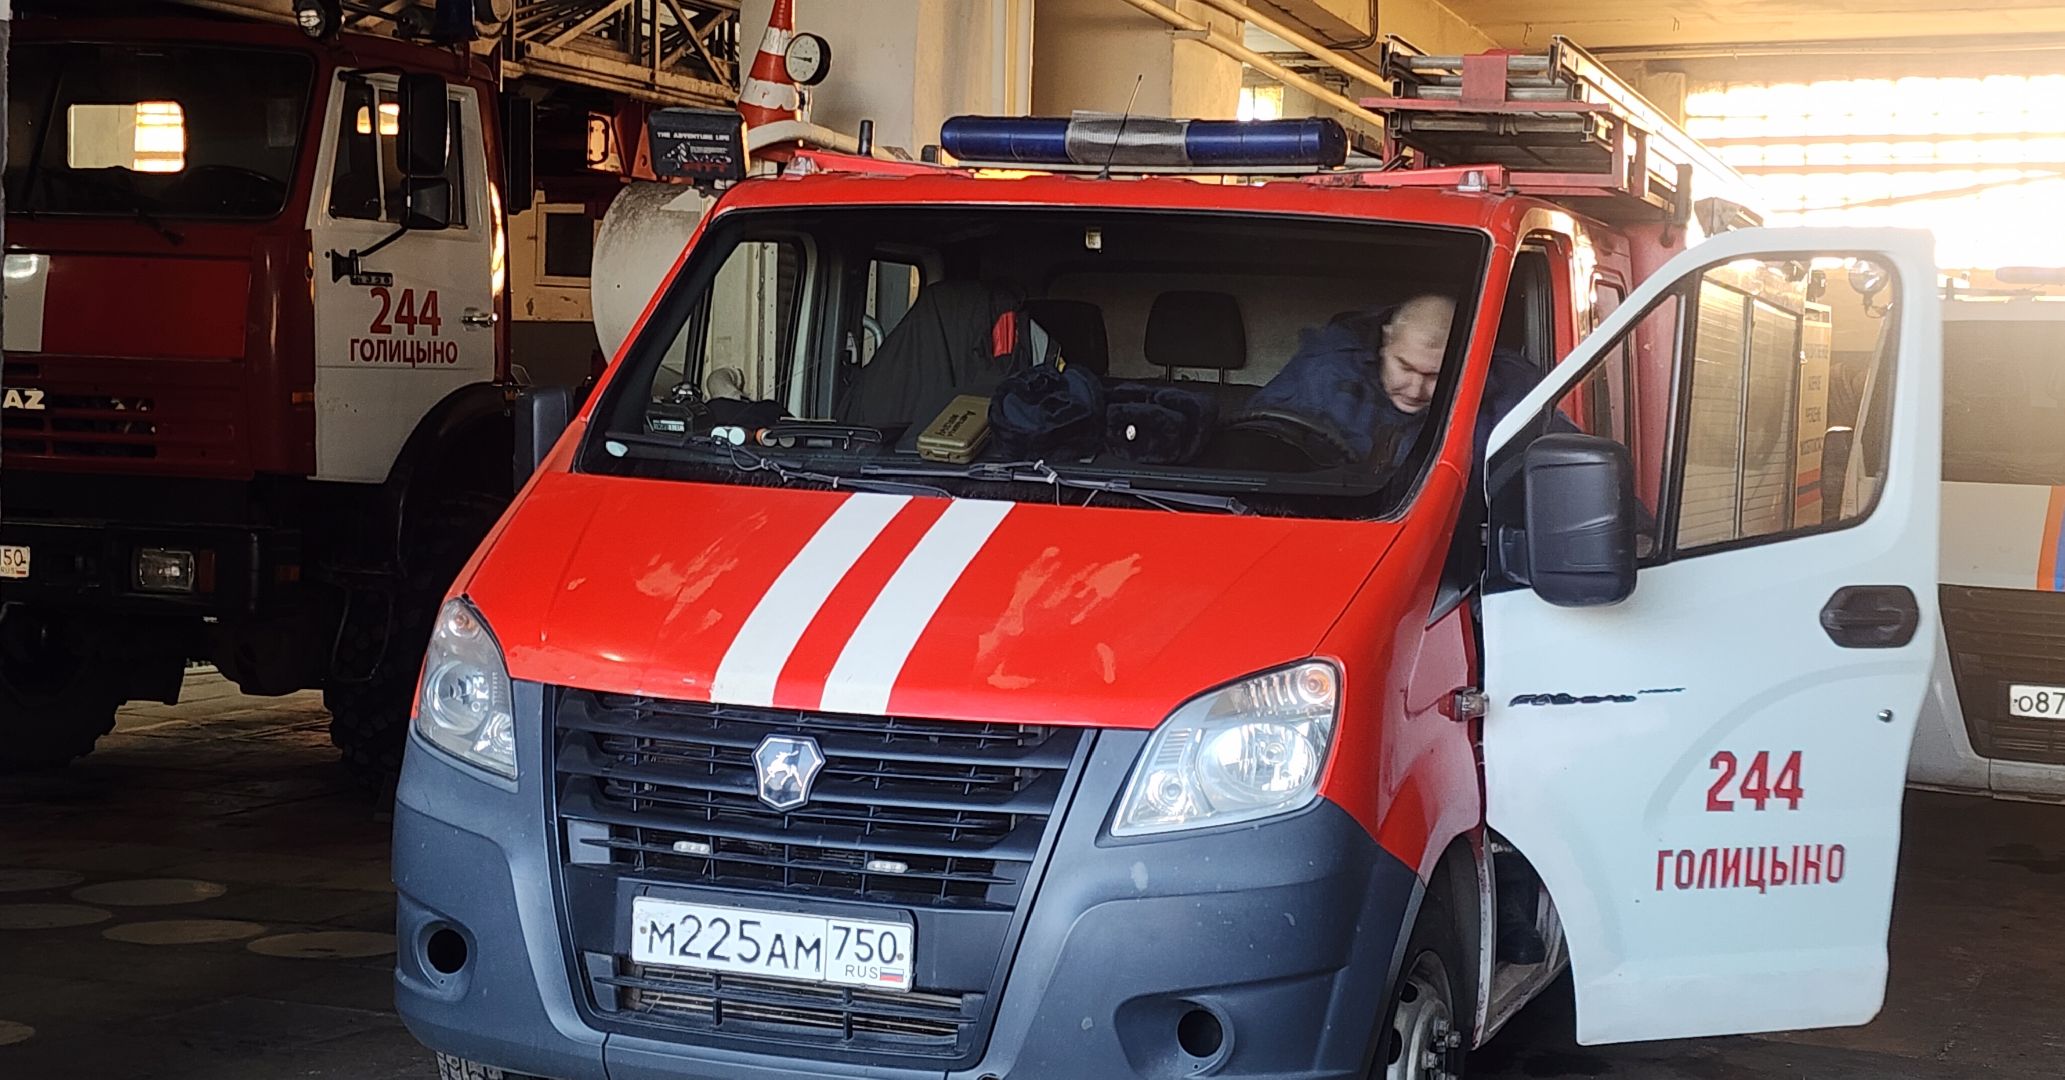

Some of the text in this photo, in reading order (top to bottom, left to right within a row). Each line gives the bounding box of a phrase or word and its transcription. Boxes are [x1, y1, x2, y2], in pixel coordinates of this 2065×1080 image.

[369, 286, 442, 337] 244
[349, 338, 459, 369] ГОЛИЦЫНО
[1705, 750, 1804, 812] 244
[1655, 844, 1845, 894] ГОЛИЦЫНО
[832, 925, 898, 964] 750
[844, 964, 879, 979] RUS
